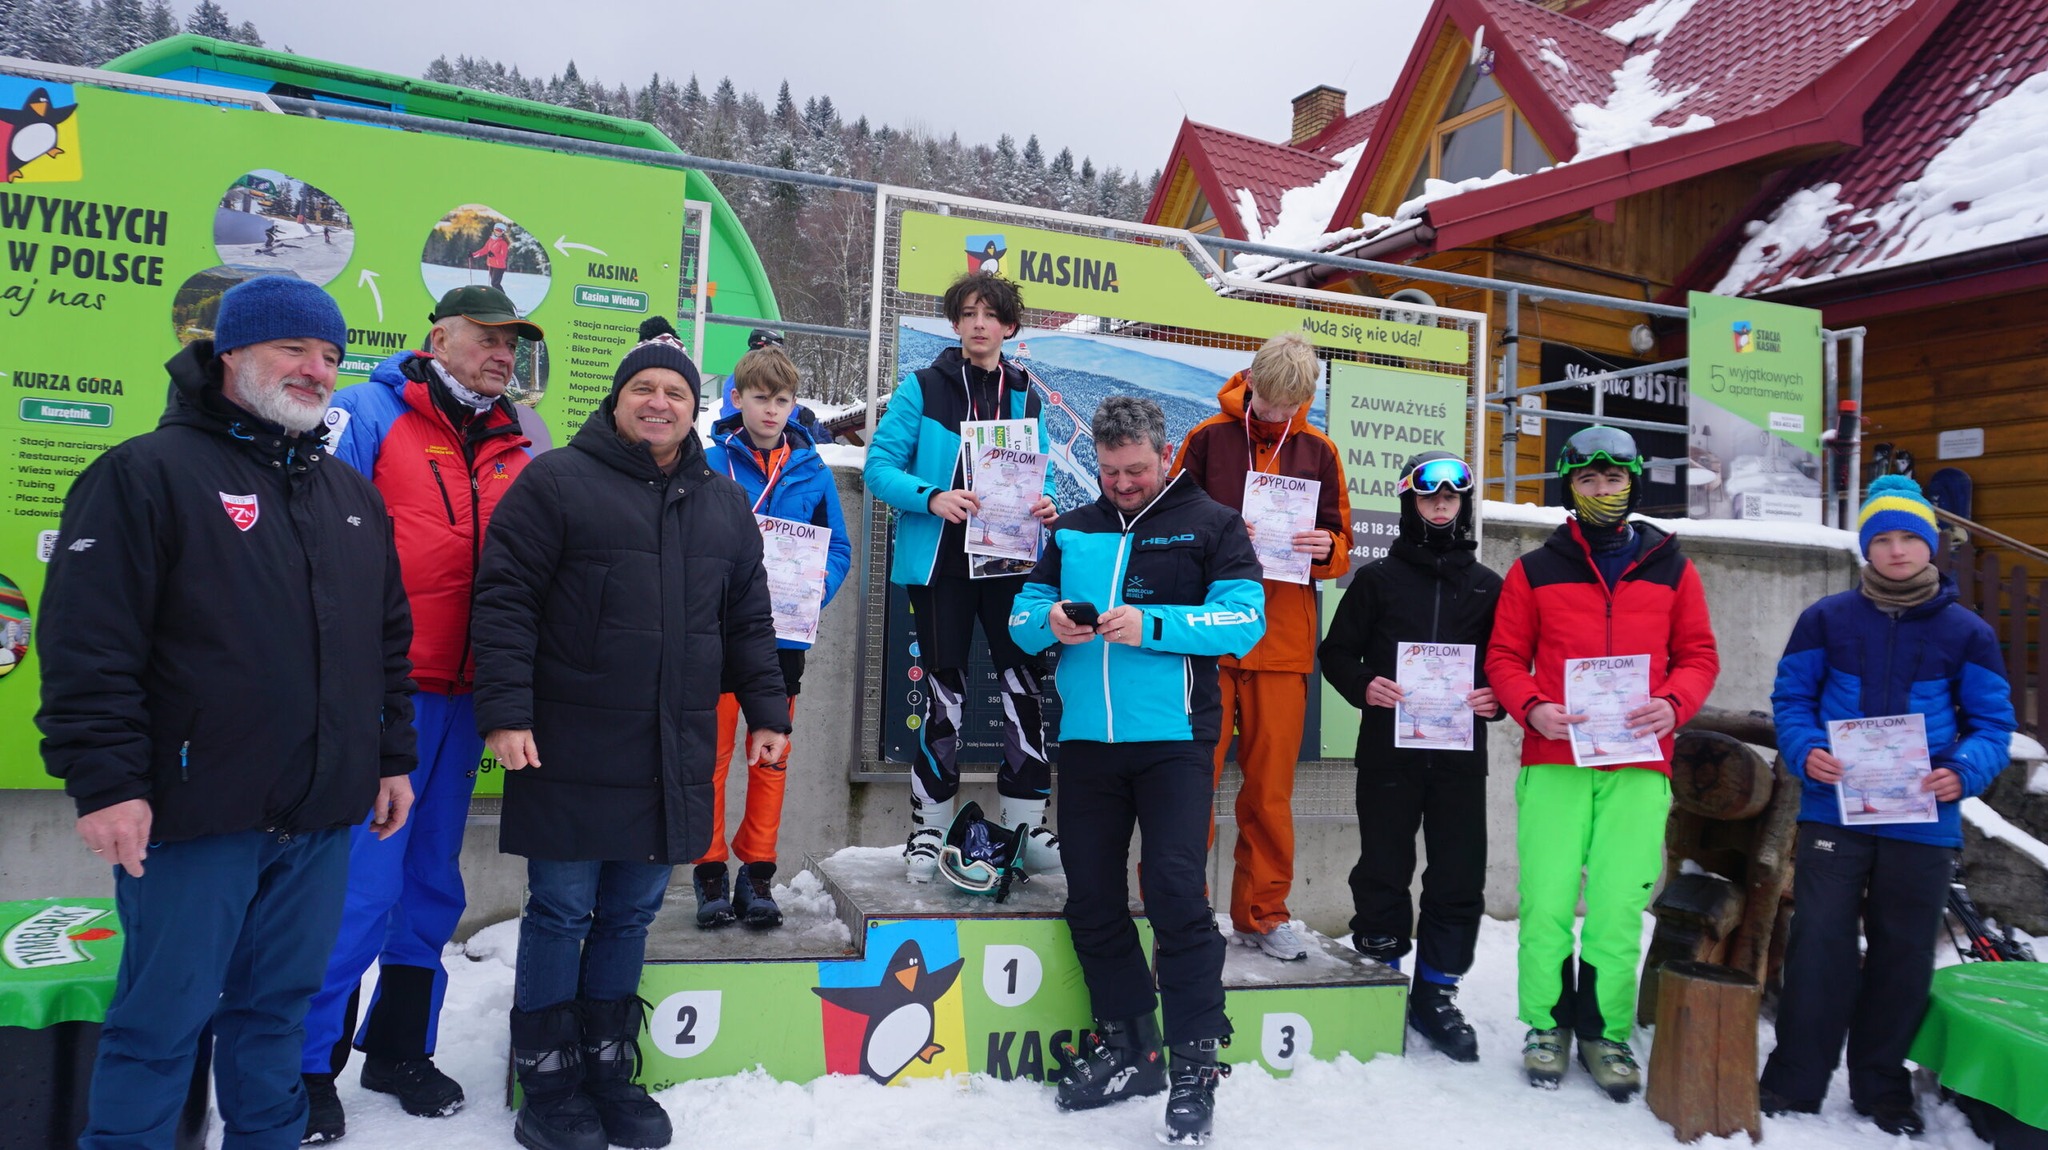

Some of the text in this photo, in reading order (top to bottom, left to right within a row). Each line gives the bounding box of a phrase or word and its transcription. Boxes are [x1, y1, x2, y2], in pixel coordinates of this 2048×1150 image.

[8, 240, 164, 286] W POLSCE
[588, 262, 638, 283] KASINA
[1019, 250, 1119, 293] KASINA
[0, 278, 106, 317] aj nas
[582, 291, 640, 307] Kasina Wielka
[573, 320, 640, 334] Stacja narciars
[1302, 316, 1423, 347] Nuda się nie uda!
[346, 328, 407, 349] OTWINY
[572, 332, 626, 346] Restauracja
[1756, 329, 1781, 341] STACJA
[571, 345, 612, 355] Bike Park
[570, 358, 610, 368] Muzeum
[13, 371, 70, 391] KURZA
[1711, 364, 1804, 393] 5 wyjątkowych
[569, 383, 600, 394] Moped
[1729, 384, 1804, 402] apartamentów
[41, 405, 91, 420] Kurzętnik
[567, 408, 587, 417] Plac
[1351, 395, 1447, 419] ZAUWAŻYŁEŚ
[1350, 420, 1445, 446] WYPADEK
[20, 437, 55, 449] Stacja
[19, 451, 86, 465] Restauracja
[992, 449, 1036, 465] DYPLOM
[1348, 448, 1411, 470] NA TR
[54, 468, 84, 477] wido
[17, 480, 55, 492] Tubing
[1260, 475, 1306, 492] DYPLOM
[1347, 477, 1400, 498] ALAR
[15, 494, 39, 503] Plac
[765, 519, 816, 540] DYPLOM
[1350, 521, 1369, 533] 48
[1371, 522, 1384, 535] 18
[1141, 534, 1195, 546] HEAD
[1372, 546, 1390, 558] 60
[1413, 646, 1461, 657] DYPLOM
[1583, 658, 1635, 671] DYPLOM
[912, 669, 919, 678] 2
[911, 693, 918, 702] 3
[988, 696, 1001, 704] 350
[910, 717, 917, 726] 4
[1848, 718, 1907, 731] DYPLOM
[15, 909, 92, 966] TYMBARK
[1003, 959, 1018, 995] 1
[675, 1005, 697, 1045] 2
[1277, 1025, 1295, 1059] 3
[987, 1029, 1092, 1083] KAS
